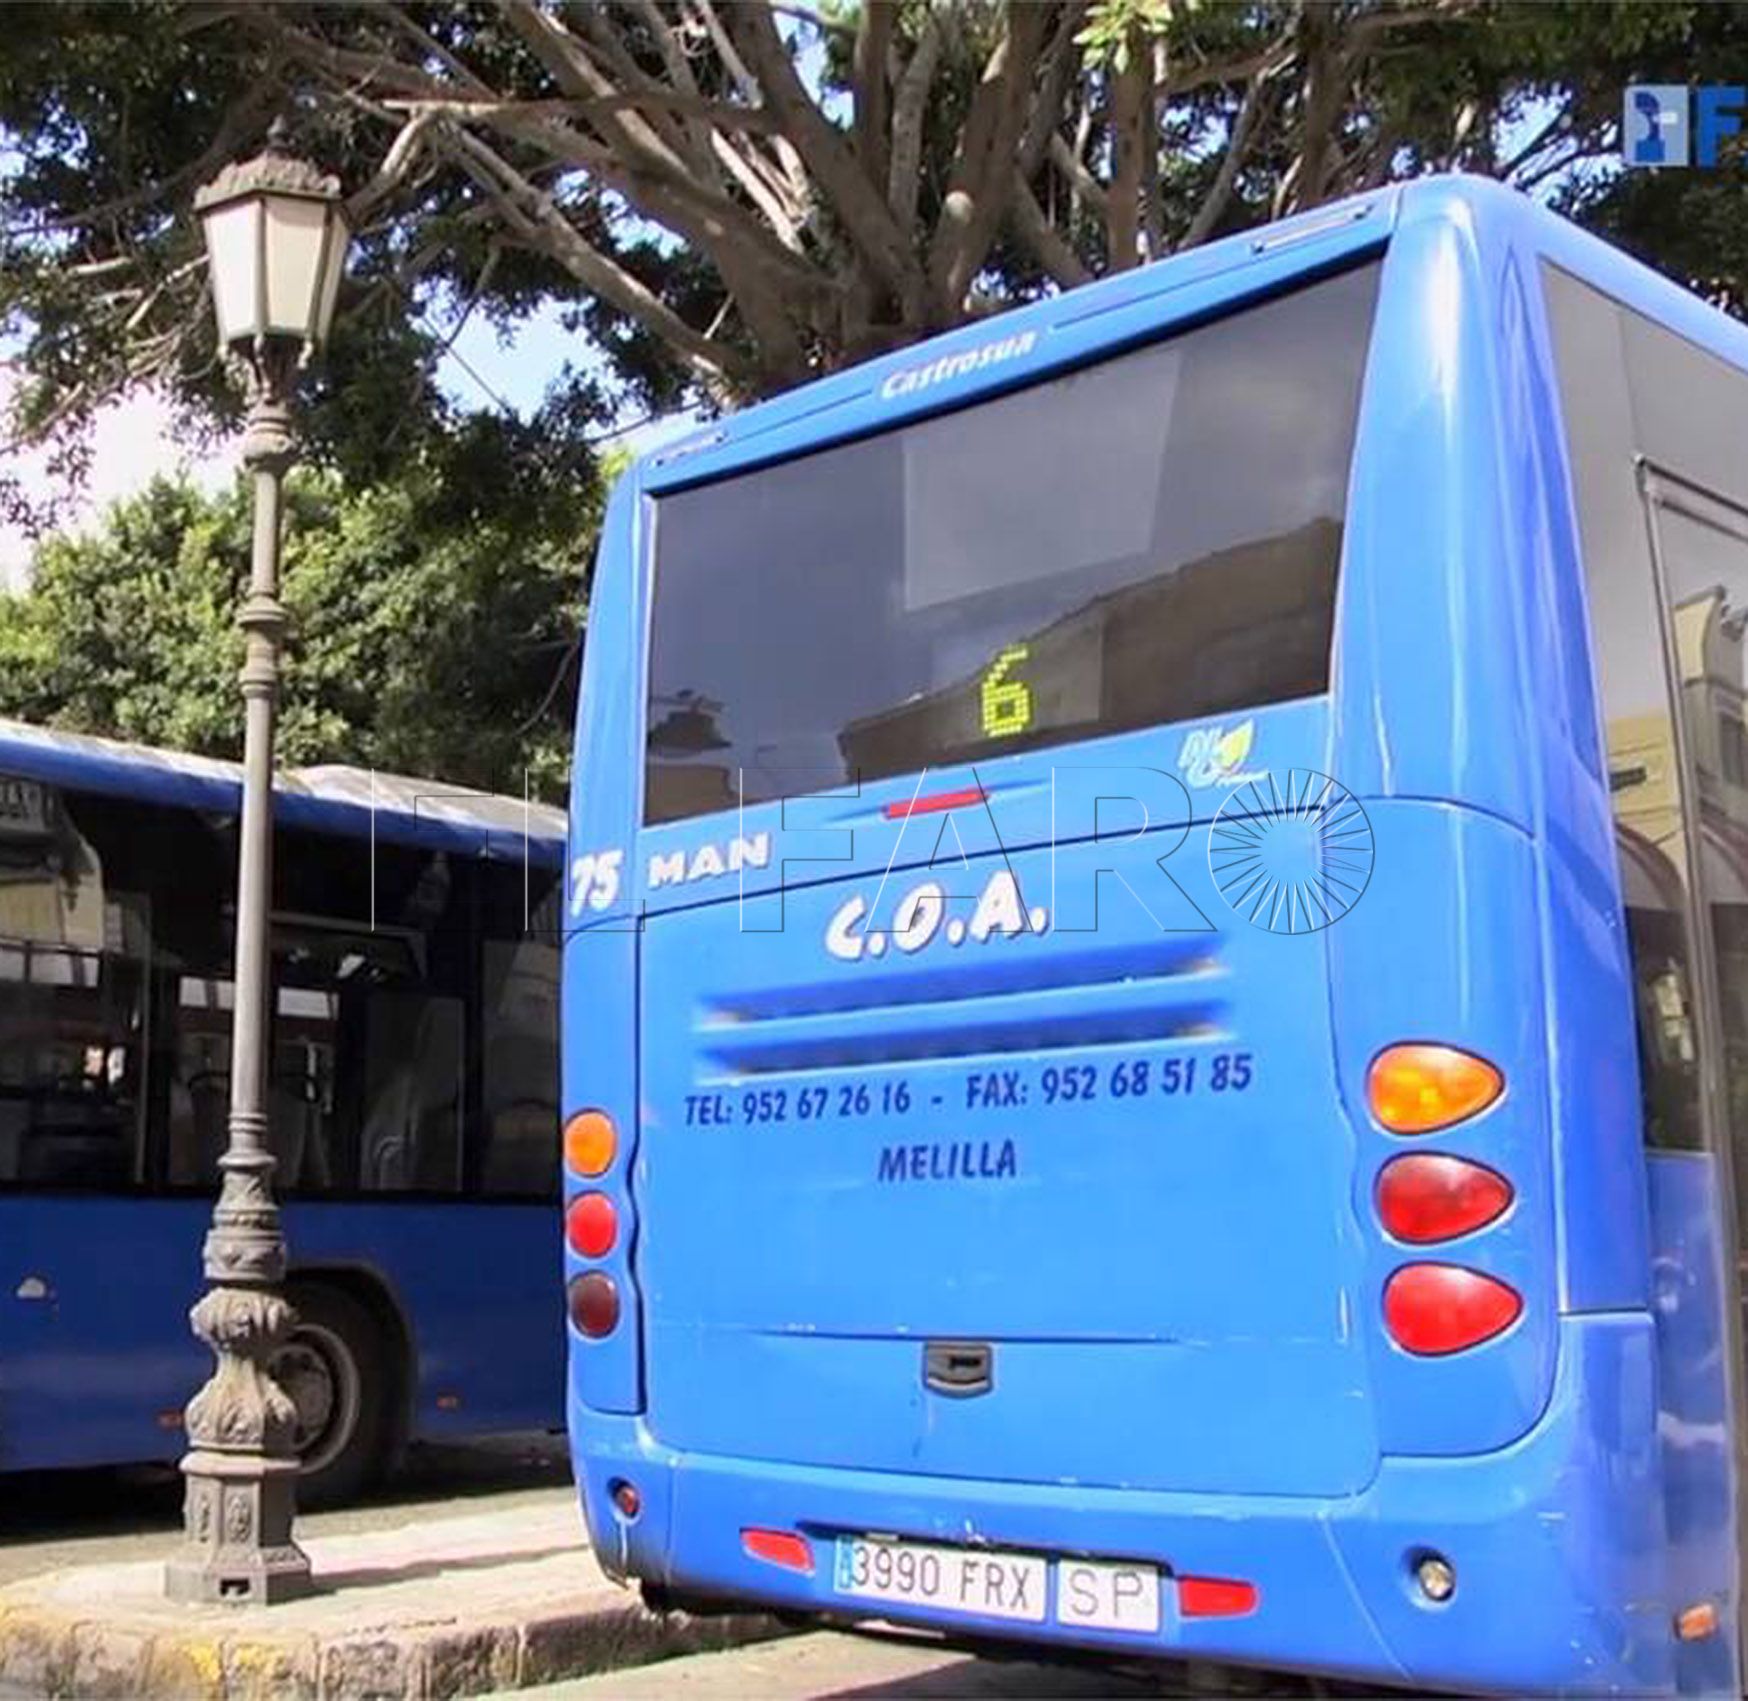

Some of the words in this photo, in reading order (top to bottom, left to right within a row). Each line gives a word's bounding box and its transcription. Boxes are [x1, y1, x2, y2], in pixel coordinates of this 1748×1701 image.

[881, 330, 1037, 400] Castrosua
[981, 645, 1029, 738] 6
[570, 849, 624, 918] 75
[648, 833, 770, 888] MAN
[825, 870, 1050, 961] C.O.A.
[684, 1095, 733, 1126] TEL:
[742, 1089, 788, 1125] 952
[797, 1087, 828, 1120] 67
[839, 1083, 870, 1118] 26
[882, 1080, 911, 1115] 16
[966, 1070, 1027, 1109] FAX:
[1041, 1065, 1097, 1105] 952
[1110, 1060, 1151, 1099] 68
[1161, 1057, 1197, 1095] 51
[1209, 1054, 1252, 1092] 85
[877, 1138, 1017, 1182] MELILLA
[852, 1545, 941, 1597] 3990
[960, 1559, 1031, 1611] FRX
[1068, 1567, 1144, 1618] SP
